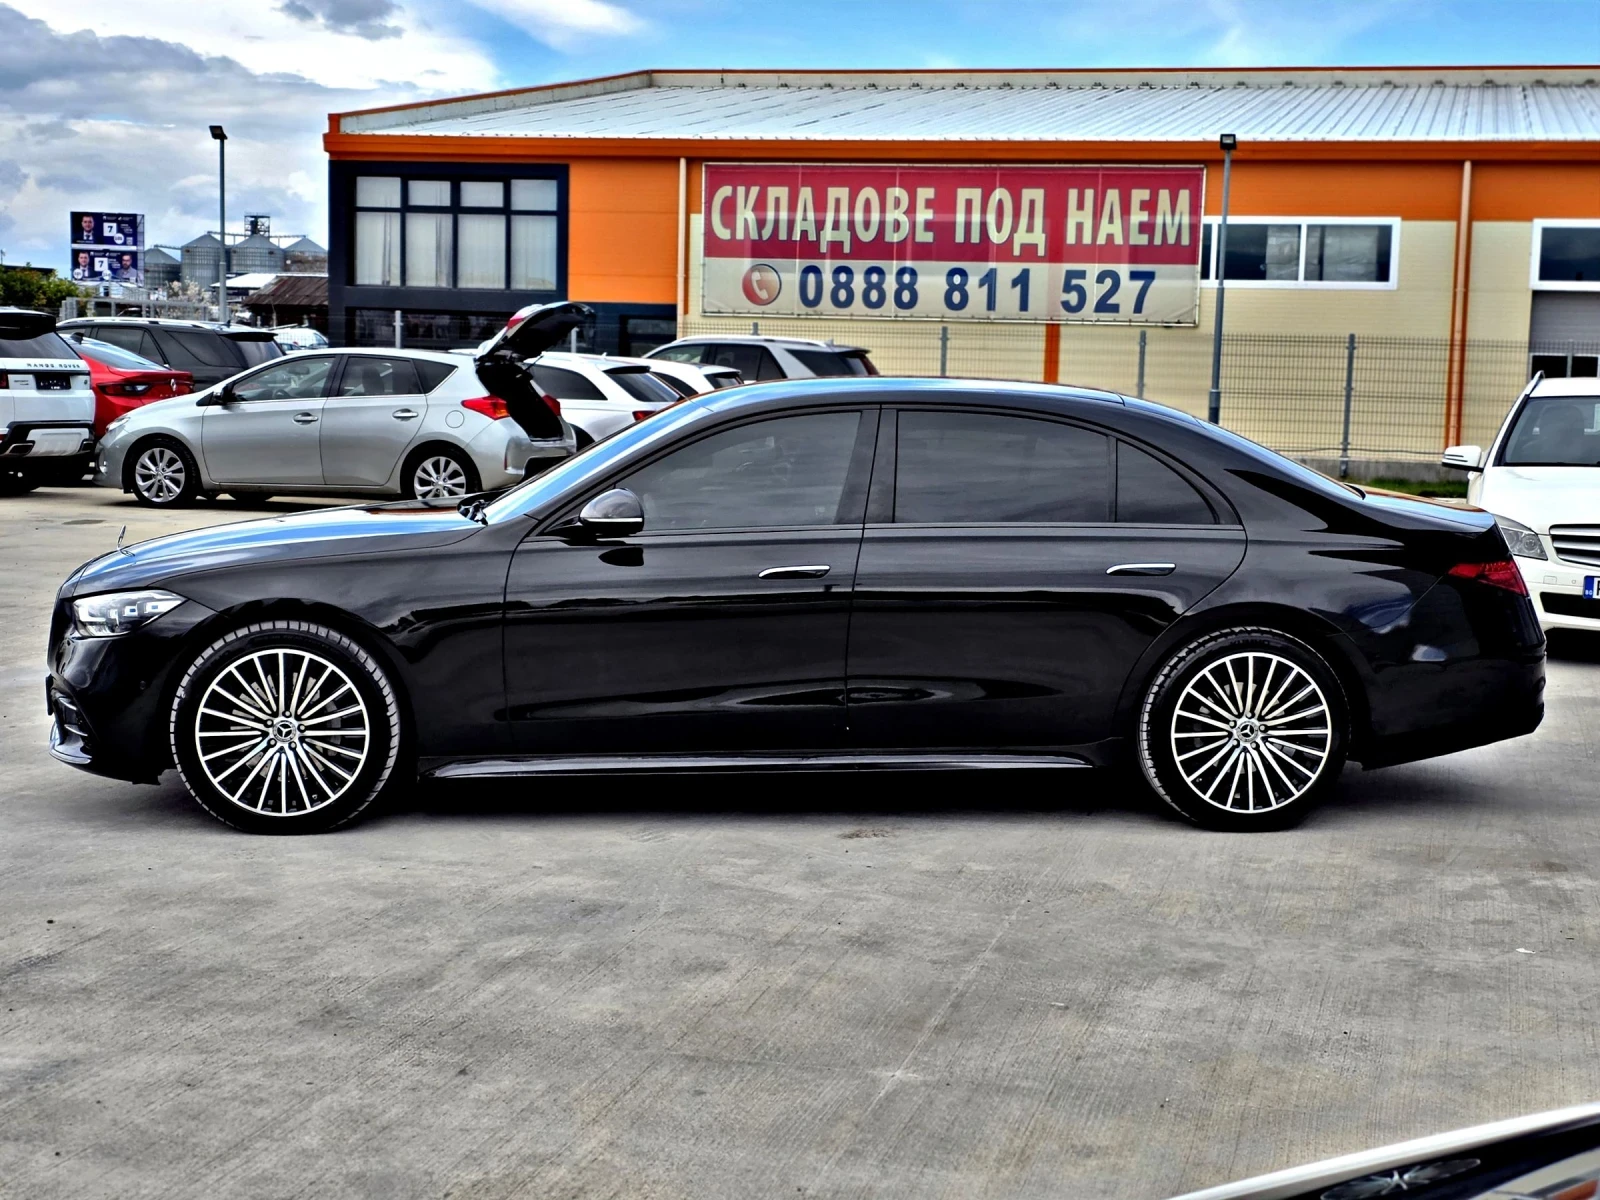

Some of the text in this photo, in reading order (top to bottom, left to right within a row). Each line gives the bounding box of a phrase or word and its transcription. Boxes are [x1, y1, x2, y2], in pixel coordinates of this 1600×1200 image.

[711, 185, 1191, 257] СКЛАДОВЕ ПОД НАЕМ
[798, 265, 1157, 315] 0888 811 527
